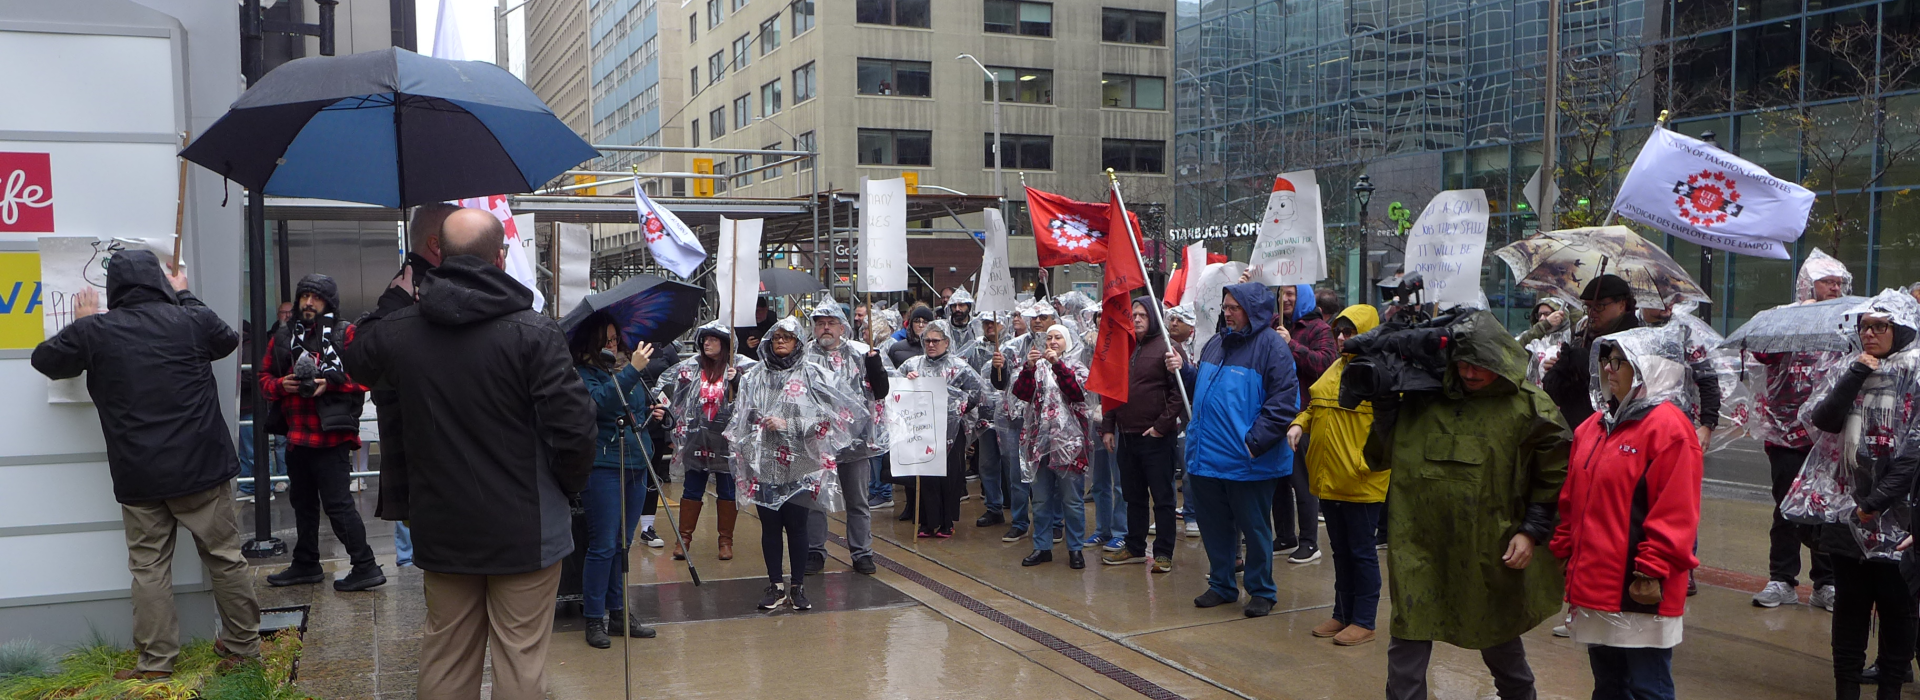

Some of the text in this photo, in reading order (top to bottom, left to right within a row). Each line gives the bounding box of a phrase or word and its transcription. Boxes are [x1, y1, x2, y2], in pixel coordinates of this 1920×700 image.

[1668, 138, 1792, 194] UNION OF TAXATION EMPLOYEES
[0, 169, 54, 225] fe
[1697, 197, 1712, 208] SEI
[1700, 189, 1719, 202] UTE
[1443, 201, 1449, 214] A
[1169, 225, 1229, 241] STARBUCKS
[1625, 202, 1656, 222] SYNDICAT
[1656, 216, 1670, 228] DES
[1724, 236, 1736, 247] DE
[1738, 240, 1774, 251] L'IMPÔT
[1417, 242, 1479, 257] IT WILL BE
[1100, 330, 1112, 362] UNION
